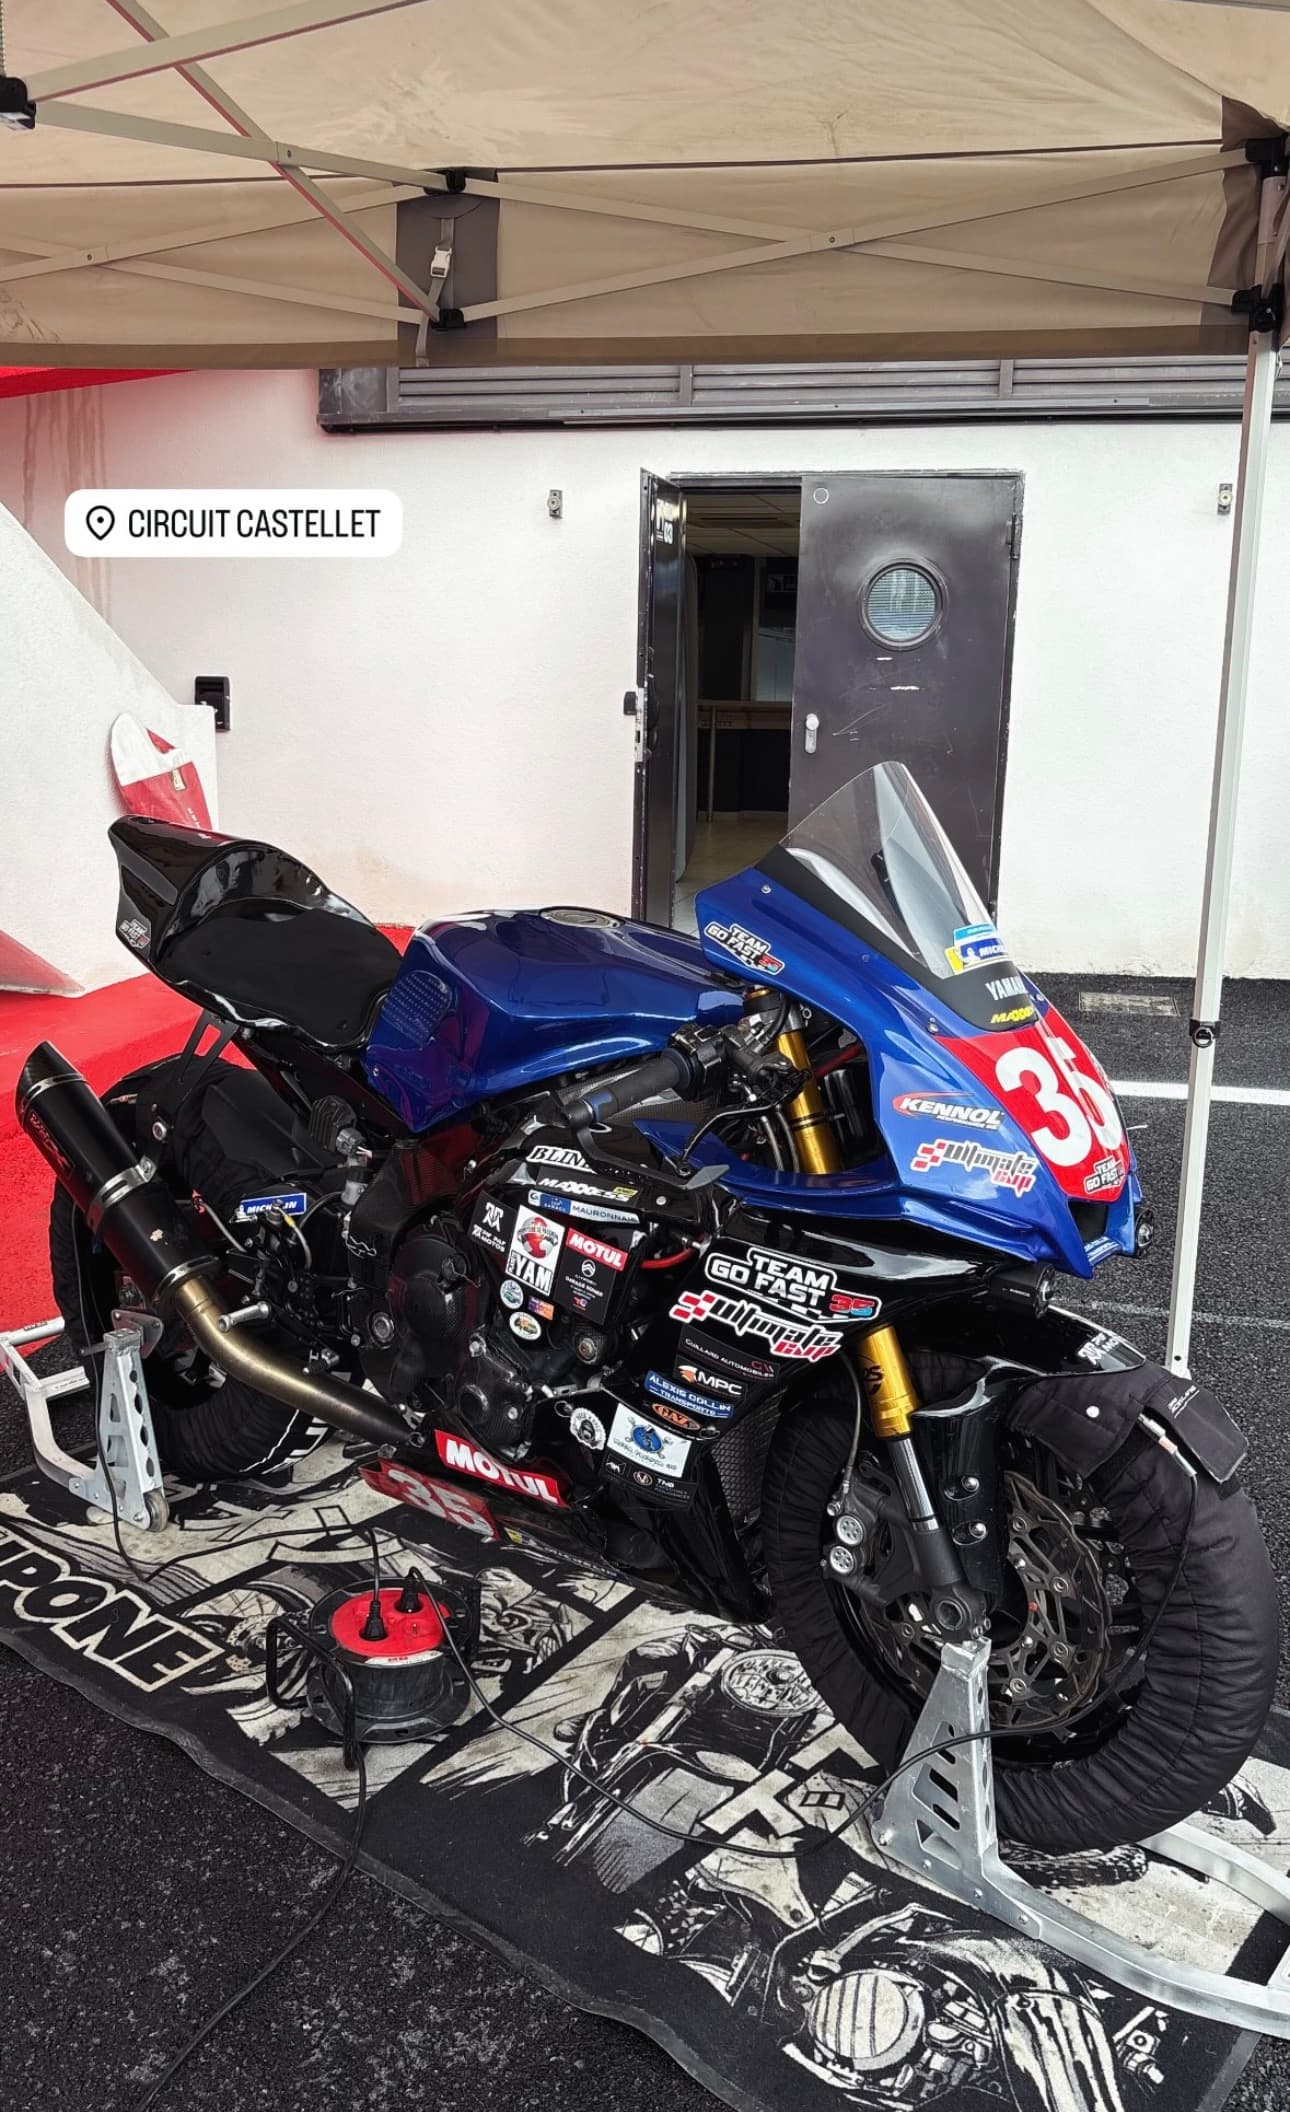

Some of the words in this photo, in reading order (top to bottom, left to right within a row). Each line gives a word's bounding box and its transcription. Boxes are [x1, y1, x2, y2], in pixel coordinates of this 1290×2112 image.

[707, 925, 729, 941] GO
[727, 936, 762, 960] FAST
[731, 927, 768, 953] TEAM
[899, 1097, 1002, 1125] KENNOL
[995, 1036, 1122, 1167] 35
[247, 1201, 297, 1214] MICHIN
[569, 1236, 624, 1269] MOTUL
[513, 1255, 552, 1293] YAM
[711, 1258, 749, 1285] GO
[754, 1274, 826, 1306] FAST
[753, 1254, 830, 1290] TEAM
[649, 1374, 687, 1397] ALEXIS
[687, 1391, 732, 1413] COLLIN
[698, 1371, 742, 1396] MPC
[446, 1438, 558, 1504] MOTUL
[387, 1467, 495, 1537] 35
